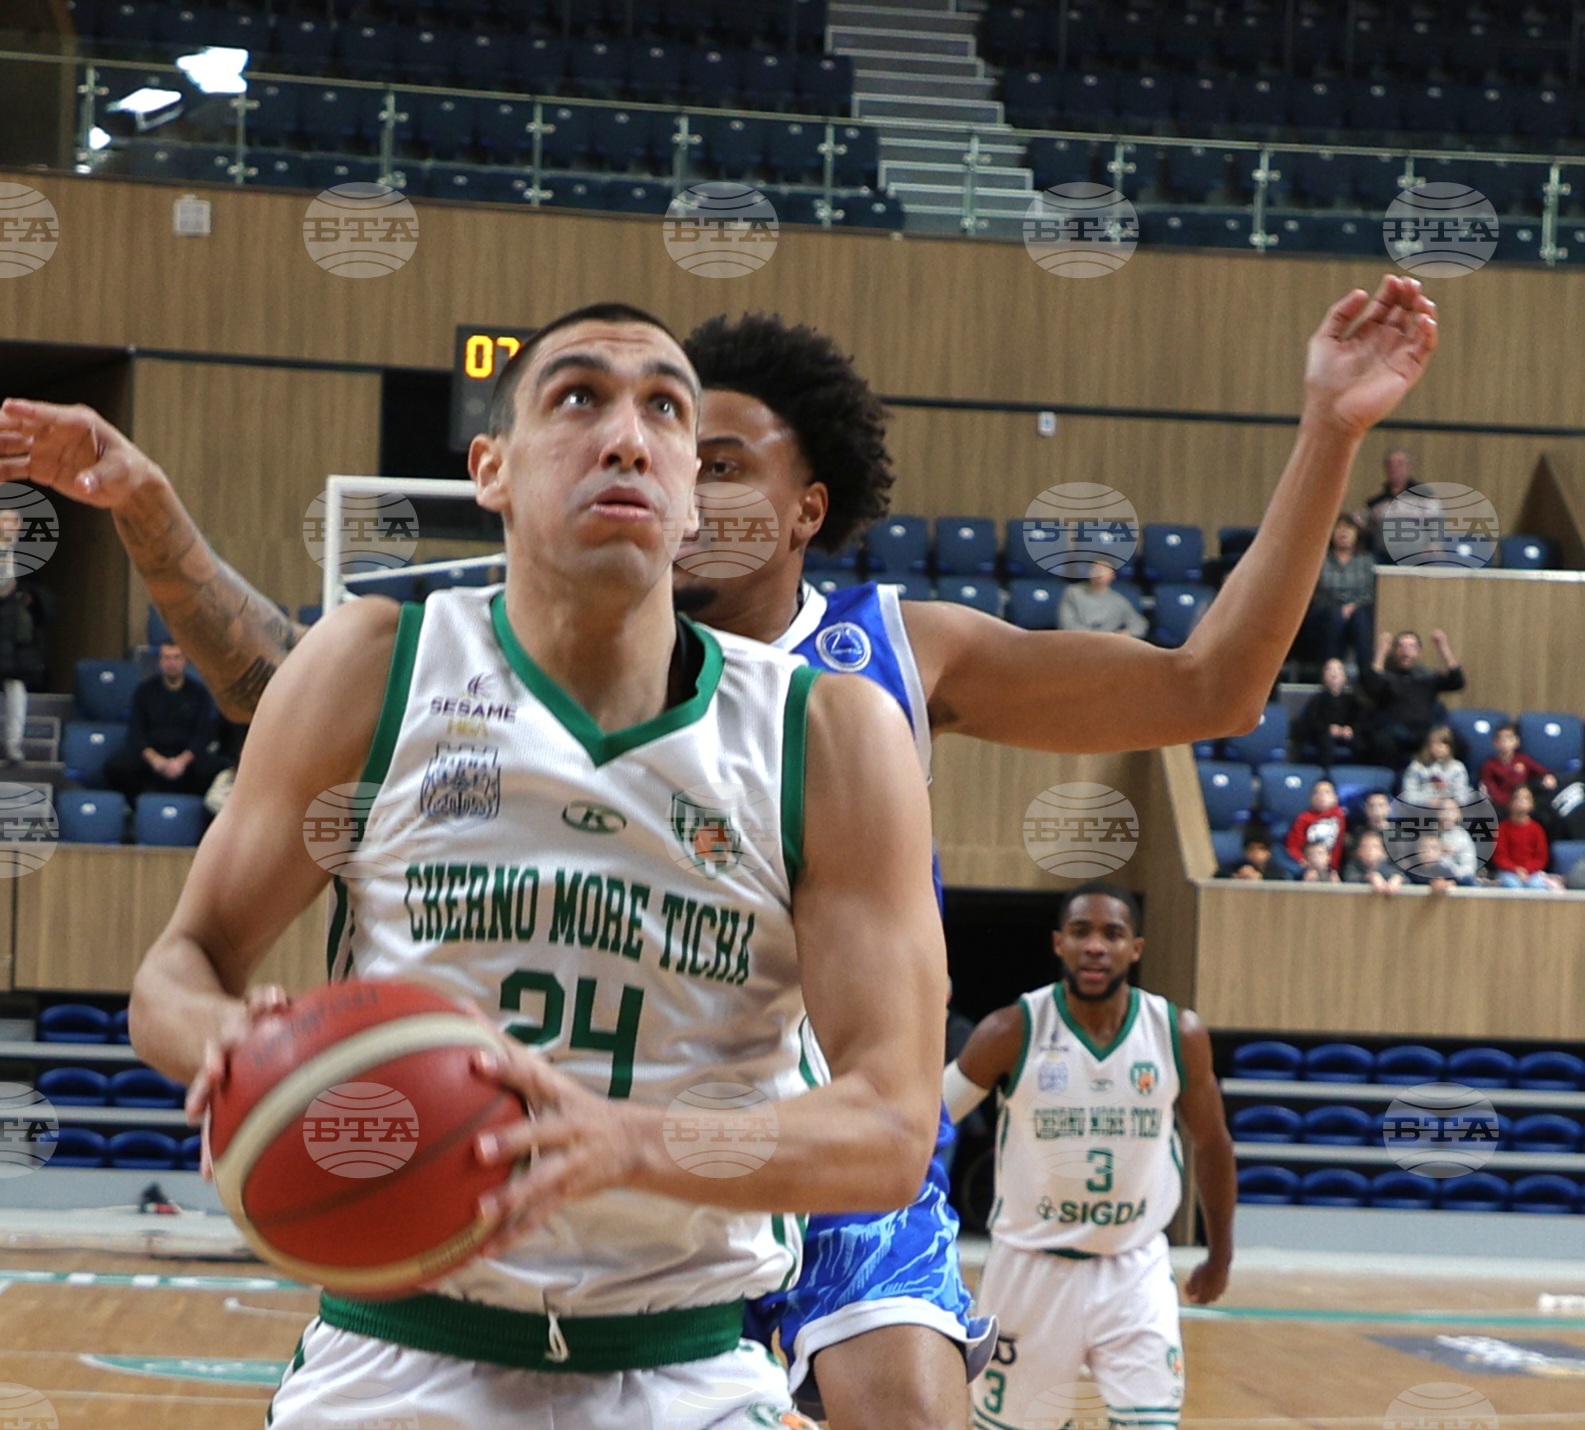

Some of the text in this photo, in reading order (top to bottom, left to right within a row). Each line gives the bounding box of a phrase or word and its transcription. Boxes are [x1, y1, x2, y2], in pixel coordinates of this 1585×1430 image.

[430, 697, 516, 723] SESAME
[404, 862, 756, 986] CHERNO MORE TICHA
[499, 968, 645, 1099] 24
[1086, 1148, 1114, 1193] 3
[1059, 1198, 1147, 1226] SIGDA
[983, 1368, 1007, 1415] 3
